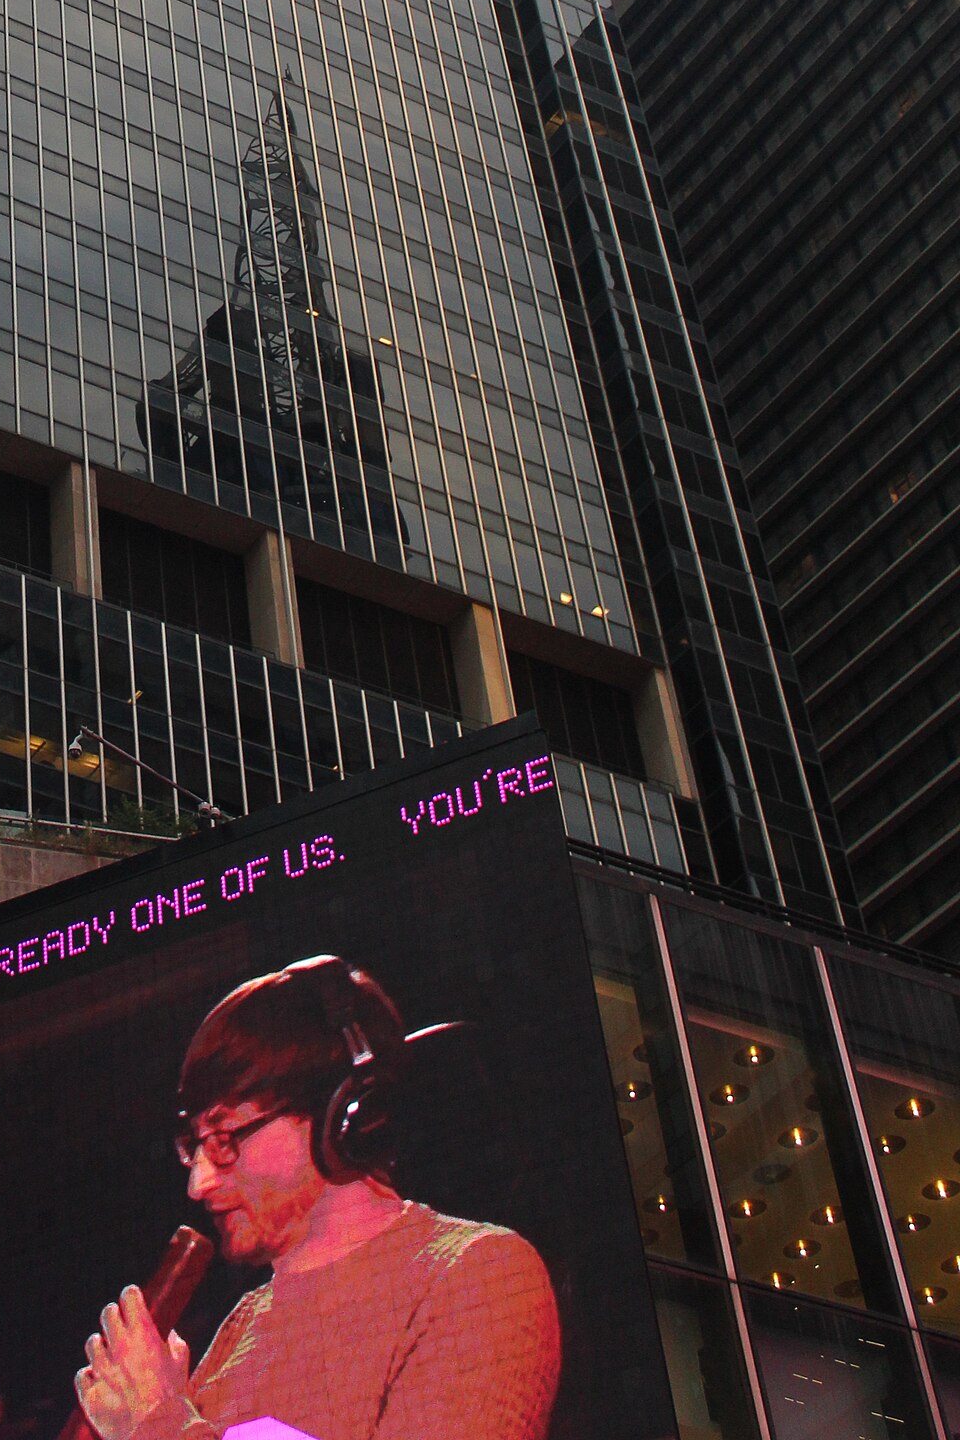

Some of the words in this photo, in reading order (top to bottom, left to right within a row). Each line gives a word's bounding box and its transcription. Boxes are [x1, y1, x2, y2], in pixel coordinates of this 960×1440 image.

[130, 878, 208, 933] ONE
[220, 855, 270, 901] OF
[283, 833, 346, 879] US.
[400, 754, 554, 836] YOU'RE
